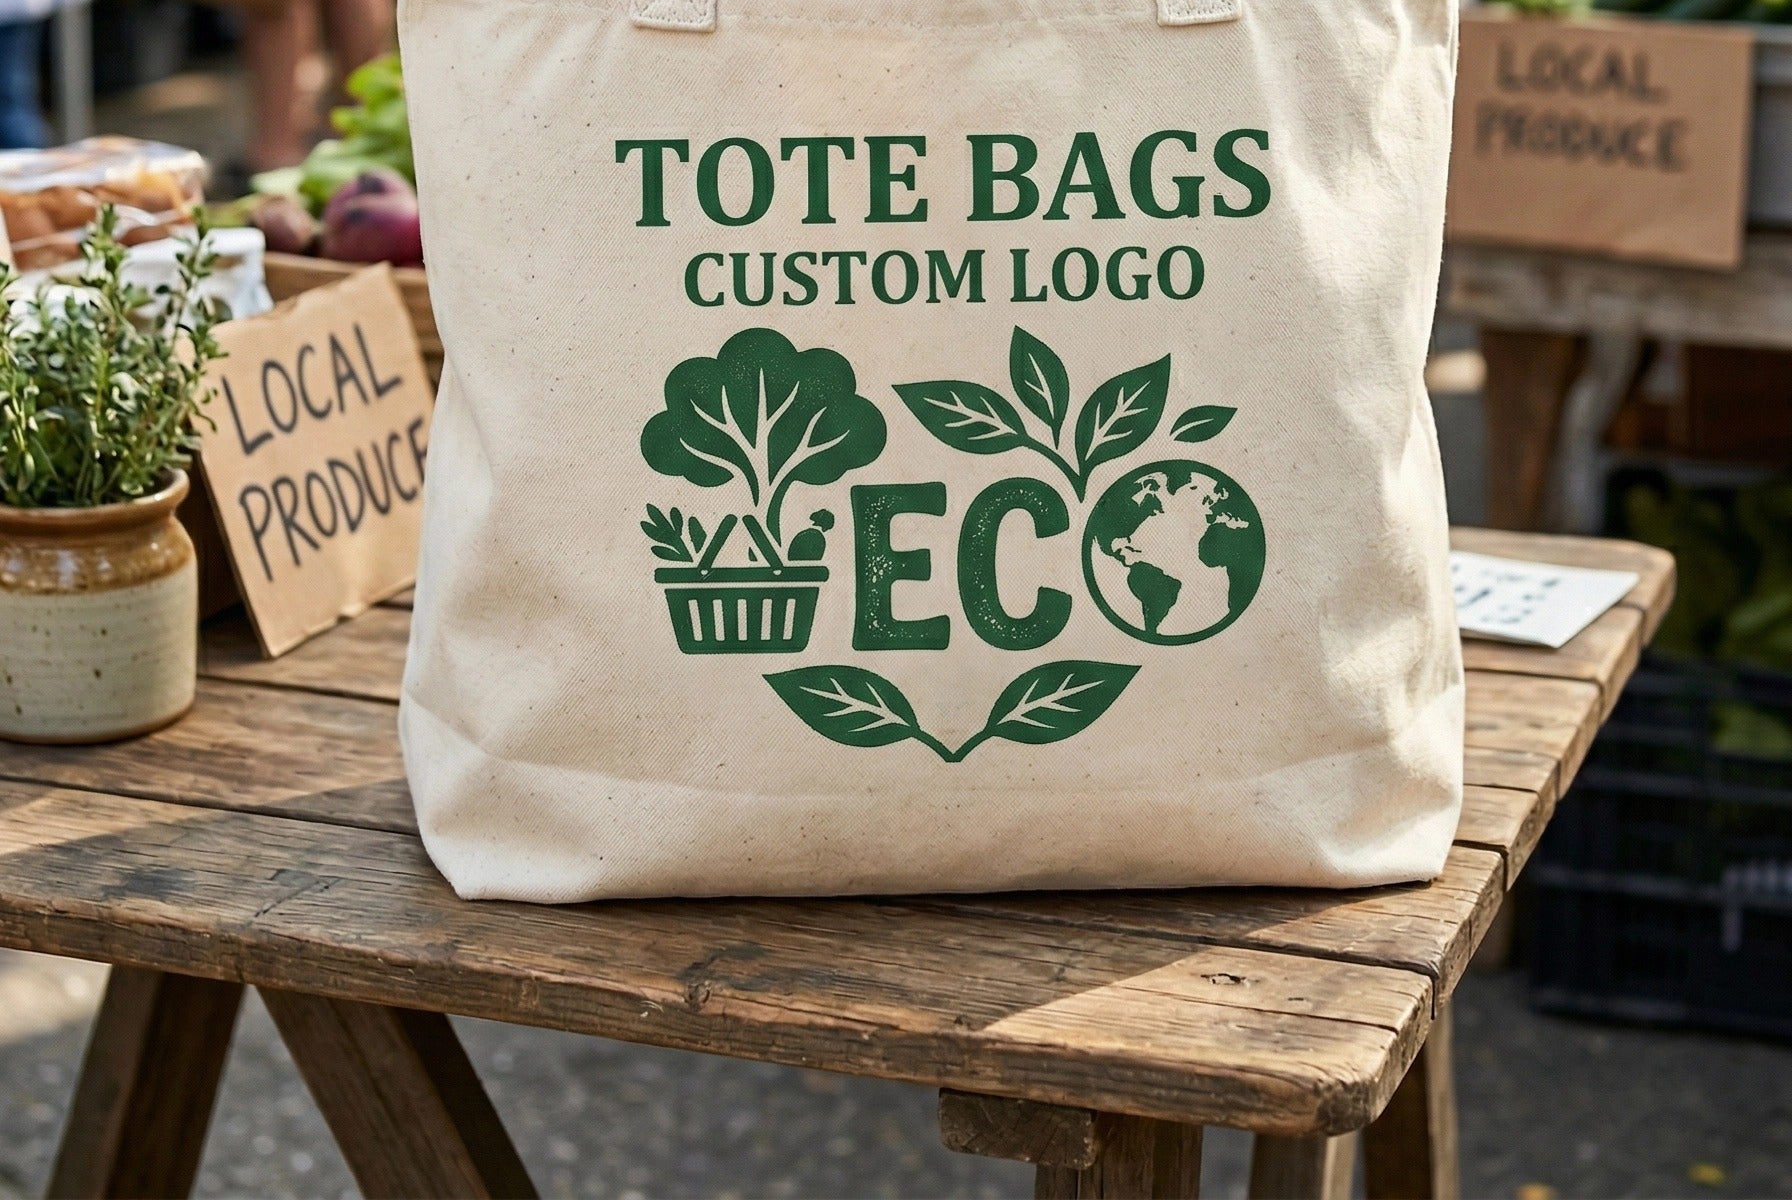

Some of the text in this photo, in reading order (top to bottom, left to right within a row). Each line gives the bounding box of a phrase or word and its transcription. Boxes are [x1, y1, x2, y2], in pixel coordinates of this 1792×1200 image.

[1496, 38, 1667, 104] LOCAL
[614, 128, 1272, 227] TOTE BAGS
[684, 245, 1206, 307] CUSTOM LOGO
[220, 323, 403, 456] LOCAL
